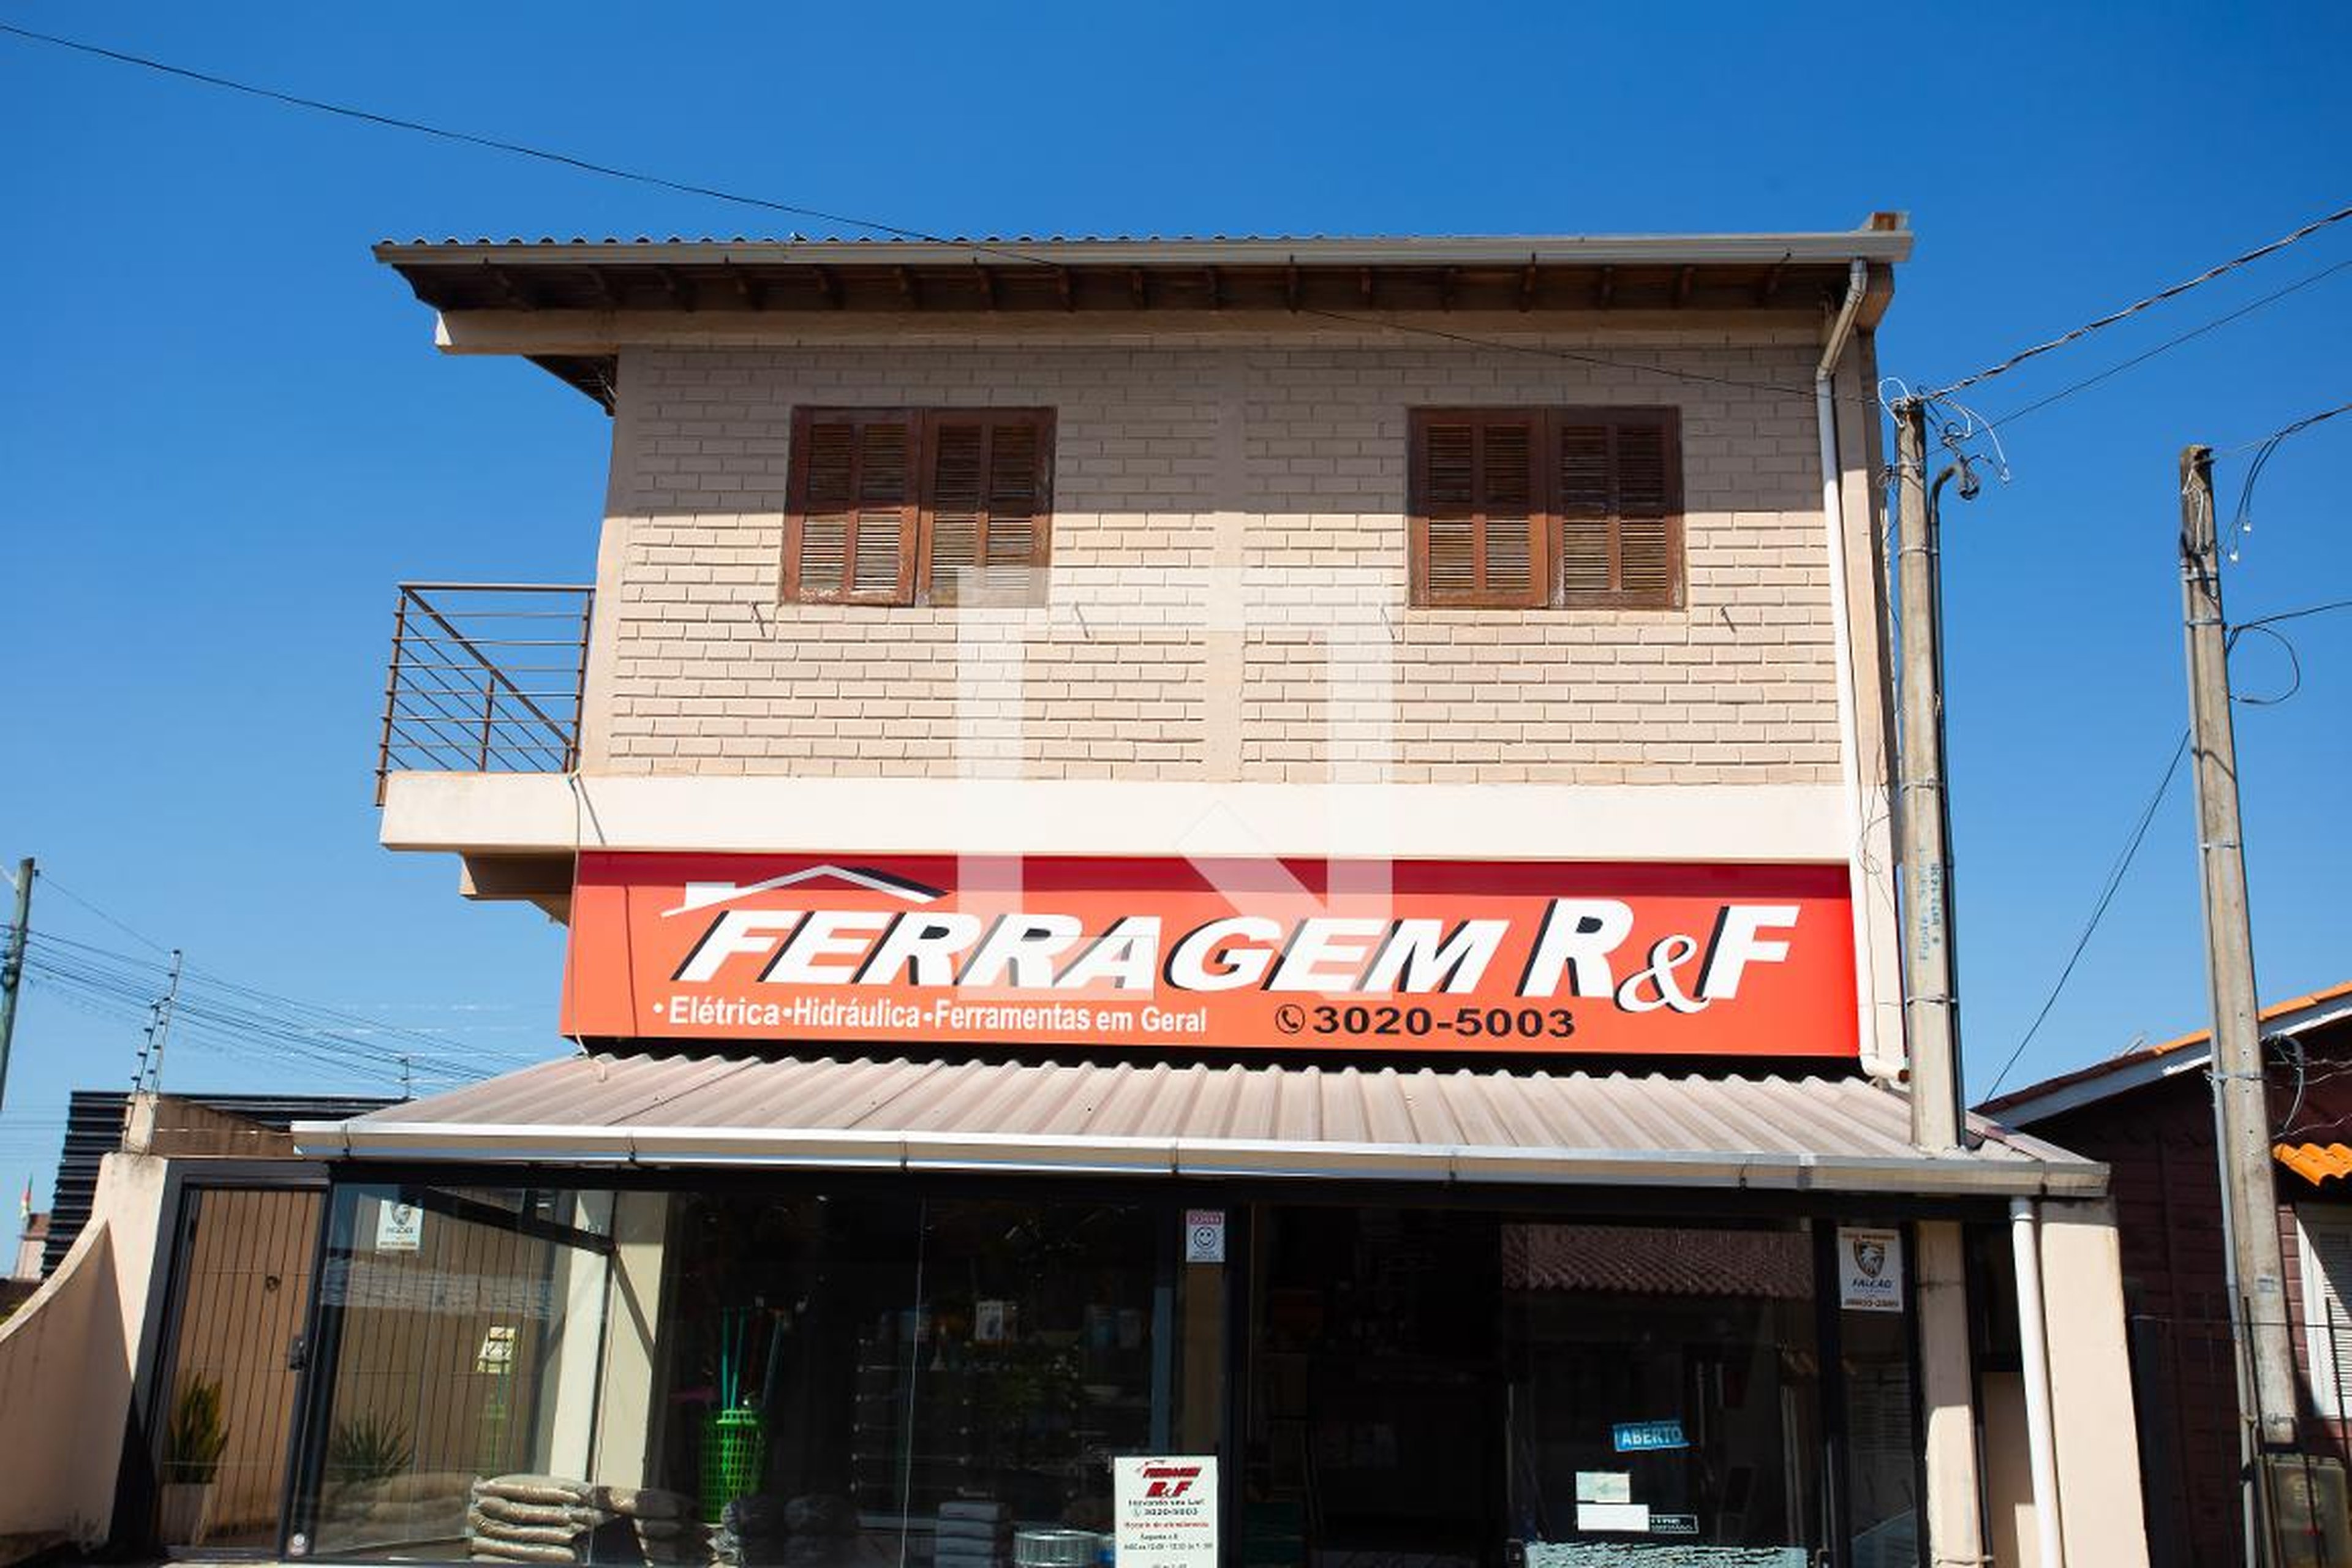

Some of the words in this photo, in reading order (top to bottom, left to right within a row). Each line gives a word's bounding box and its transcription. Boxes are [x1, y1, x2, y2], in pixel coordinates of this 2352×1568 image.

[670, 911, 1510, 993] FERRAGEM
[1515, 898, 1801, 1014] R&F
[669, 995, 780, 1026] Elétrica
[793, 995, 919, 1028] Hidráulica
[935, 999, 1091, 1031] Ferramentas
[1096, 1011, 1133, 1031] em
[1141, 1006, 1207, 1033] Geral
[1312, 1006, 1576, 1038] 3020-5003
[1622, 1426, 1683, 1446] ABERTO
